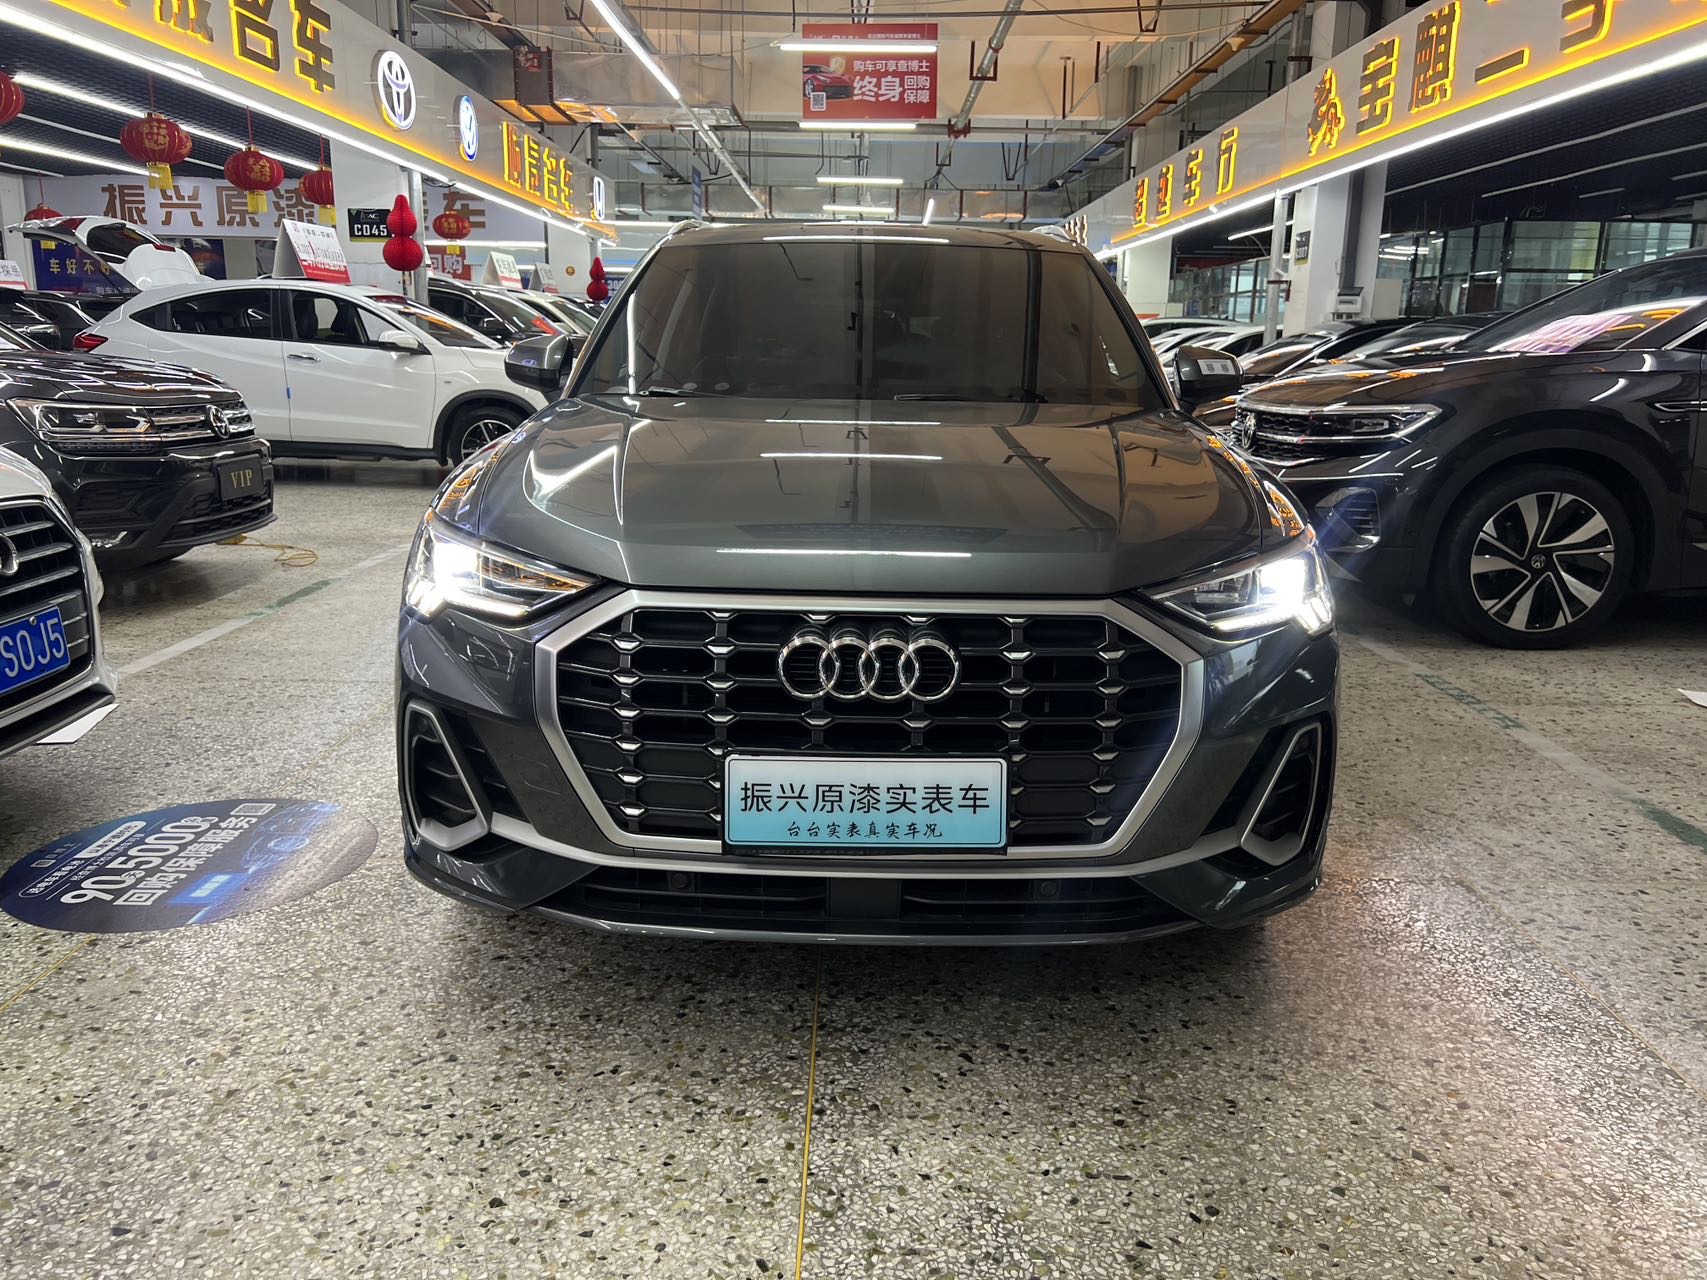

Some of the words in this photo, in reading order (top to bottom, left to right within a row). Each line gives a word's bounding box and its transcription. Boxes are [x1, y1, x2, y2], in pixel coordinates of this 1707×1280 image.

[112, 0, 335, 94] 名车
[853, 60, 930, 72] 购车可享查博士
[853, 75, 902, 102] 终身
[904, 75, 930, 89] 回购
[904, 89, 930, 104] 保障
[101, 183, 316, 228] 振兴原漆
[230, 469, 253, 489] VIP
[740, 781, 990, 815] 振兴原漆实表车
[787, 821, 943, 840] 台台实表真实车况
[112, 817, 258, 905] 回购保障服务
